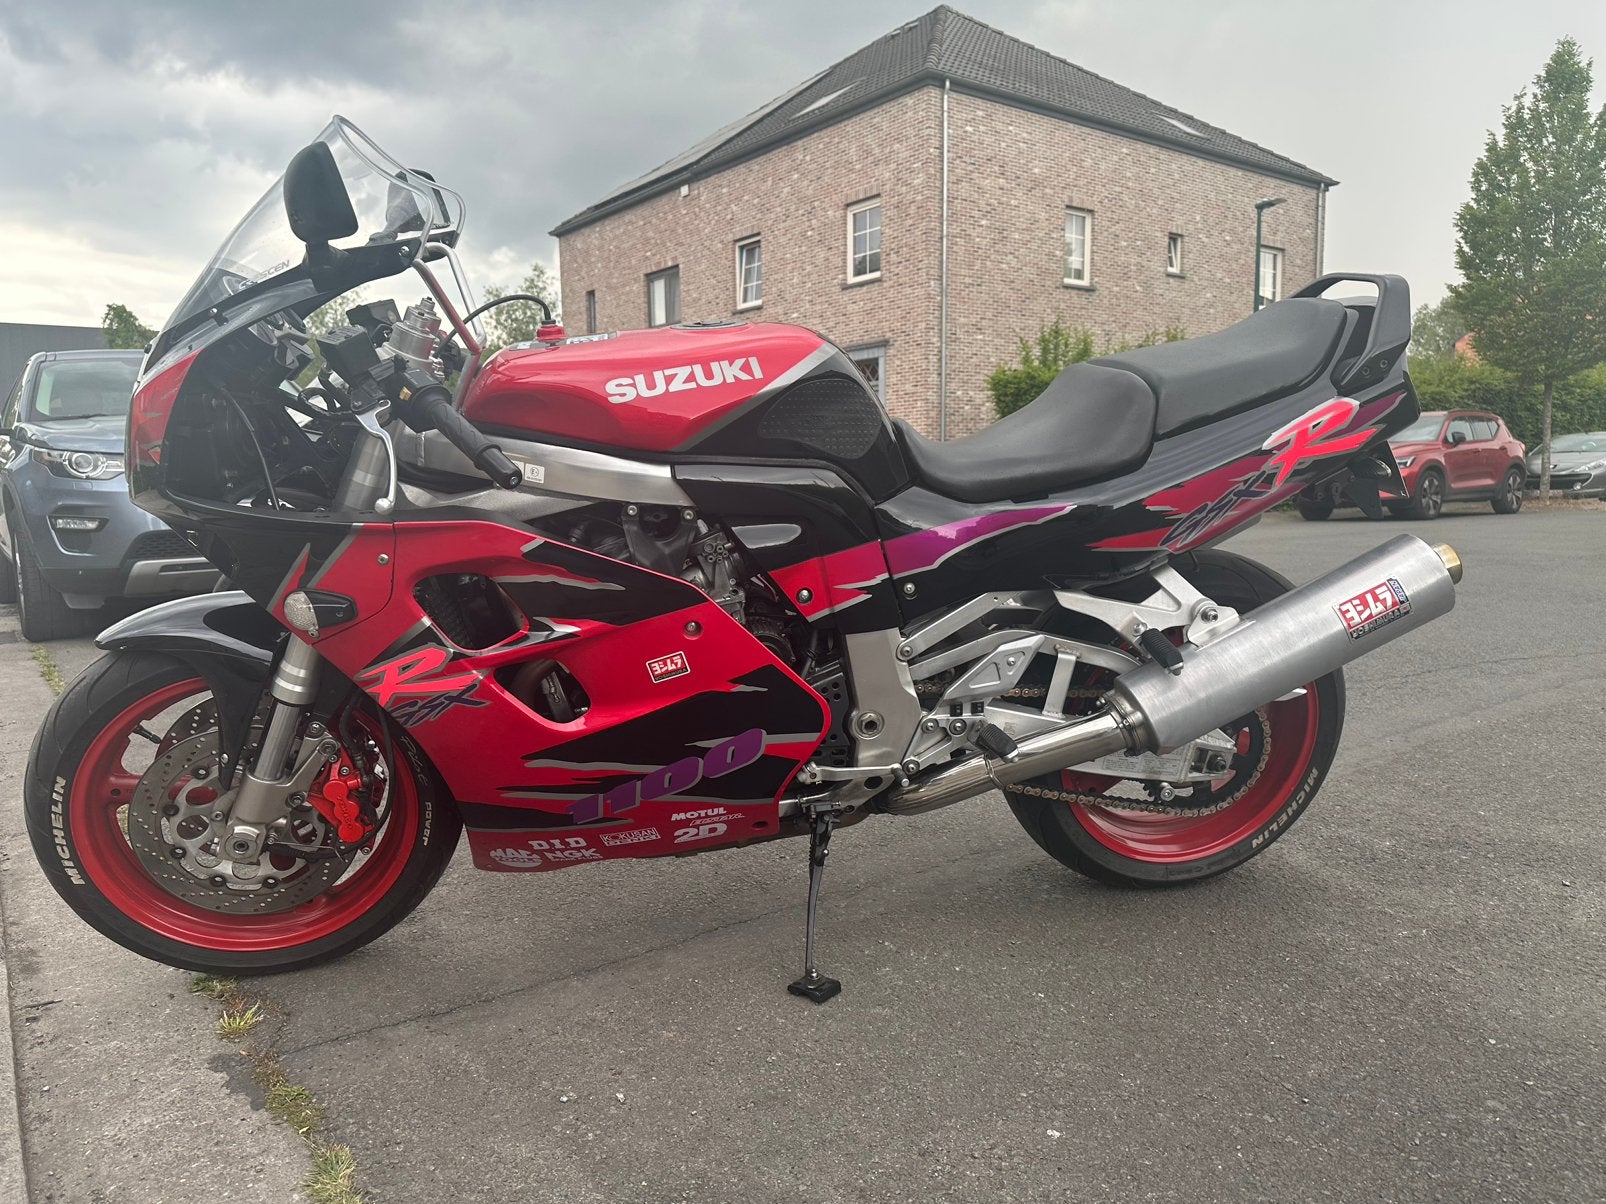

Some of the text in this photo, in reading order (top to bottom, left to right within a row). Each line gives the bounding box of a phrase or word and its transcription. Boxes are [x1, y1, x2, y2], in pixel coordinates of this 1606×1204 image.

[605, 357, 763, 404] SUZUKI
[1262, 397, 1387, 487] R
[1340, 585, 1393, 627] ヨシムラ
[355, 642, 490, 707] R
[651, 656, 682, 675] ヨシムラ
[566, 728, 767, 824] 1100
[671, 807, 727, 821] MOTUL
[1252, 767, 1318, 849] MICHELIN
[51, 776, 86, 885] MICHELIN
[603, 828, 658, 842] KOKUSAN
[674, 823, 728, 844] 2D
[544, 848, 600, 861] NGK
